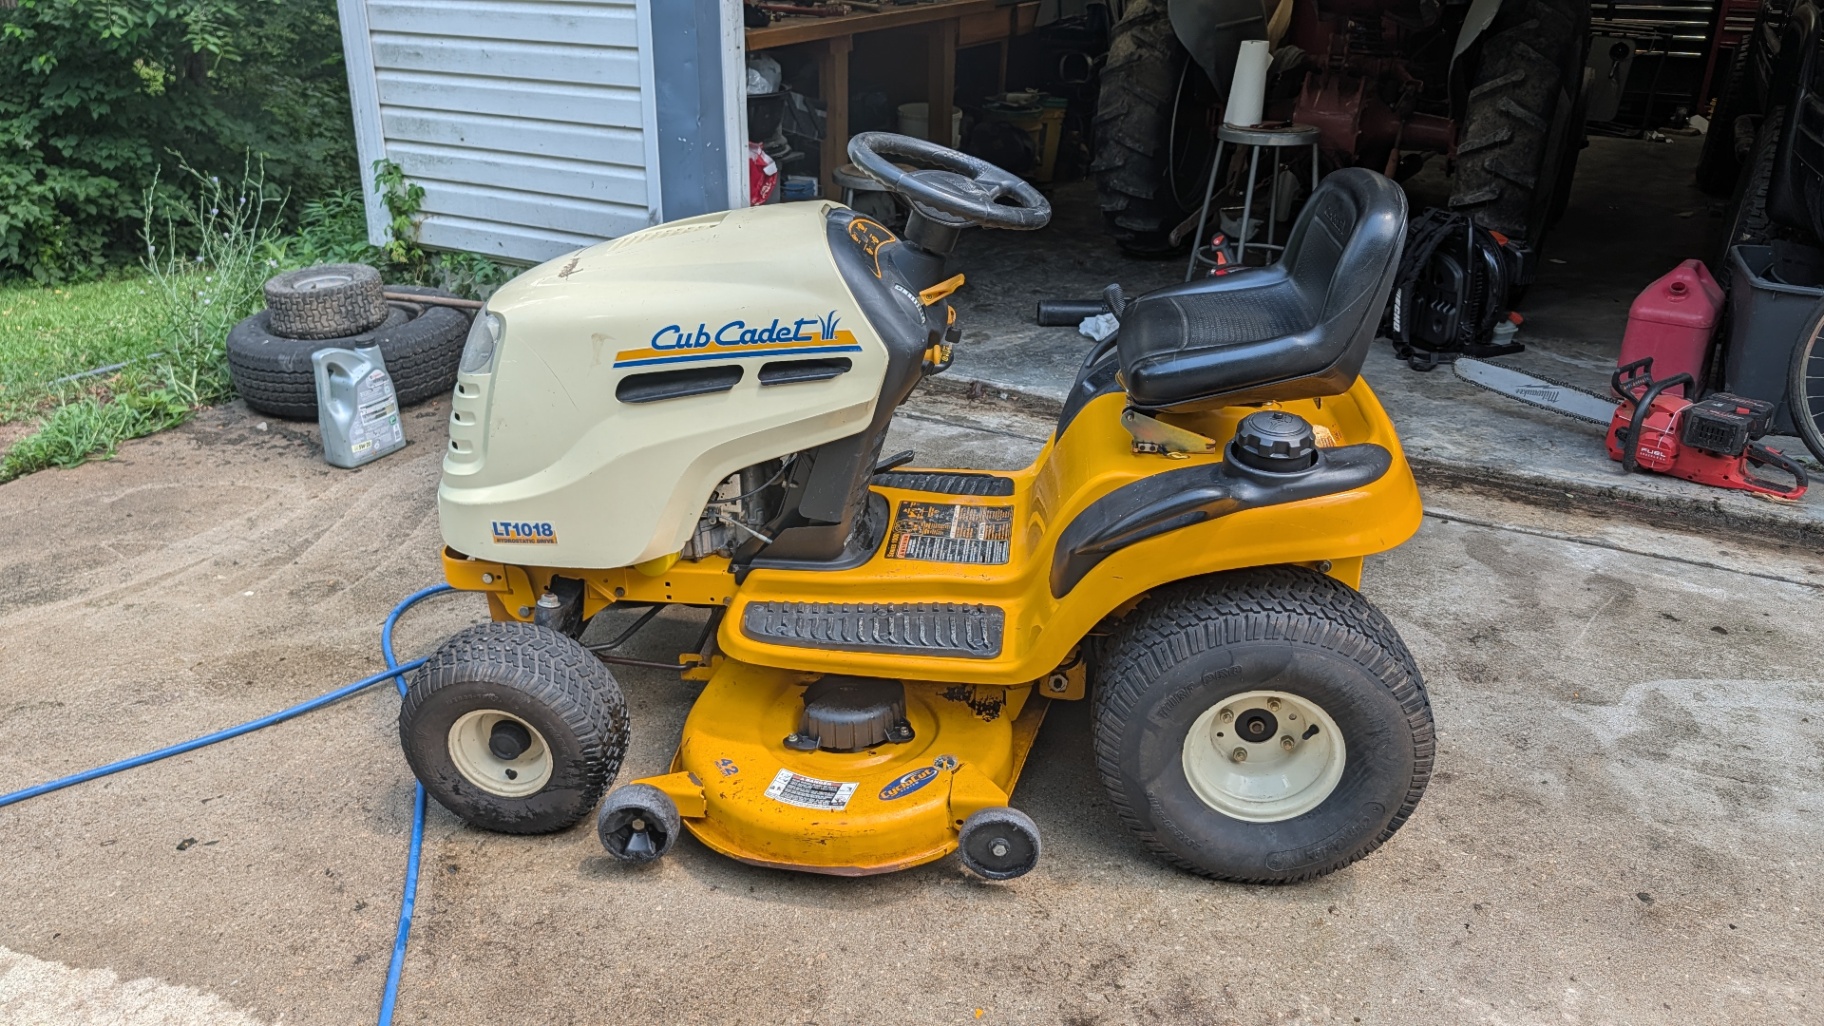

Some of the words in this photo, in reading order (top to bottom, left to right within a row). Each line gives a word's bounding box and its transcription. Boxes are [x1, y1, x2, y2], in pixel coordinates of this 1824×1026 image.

[1393, 298, 1401, 333] ECHO
[651, 323, 711, 350] Cub
[714, 318, 818, 346] Cadet
[1515, 389, 1560, 404] Milwaukee
[1640, 447, 1667, 458] FUEL
[492, 521, 554, 537] LT1018
[720, 758, 739, 776] 42
